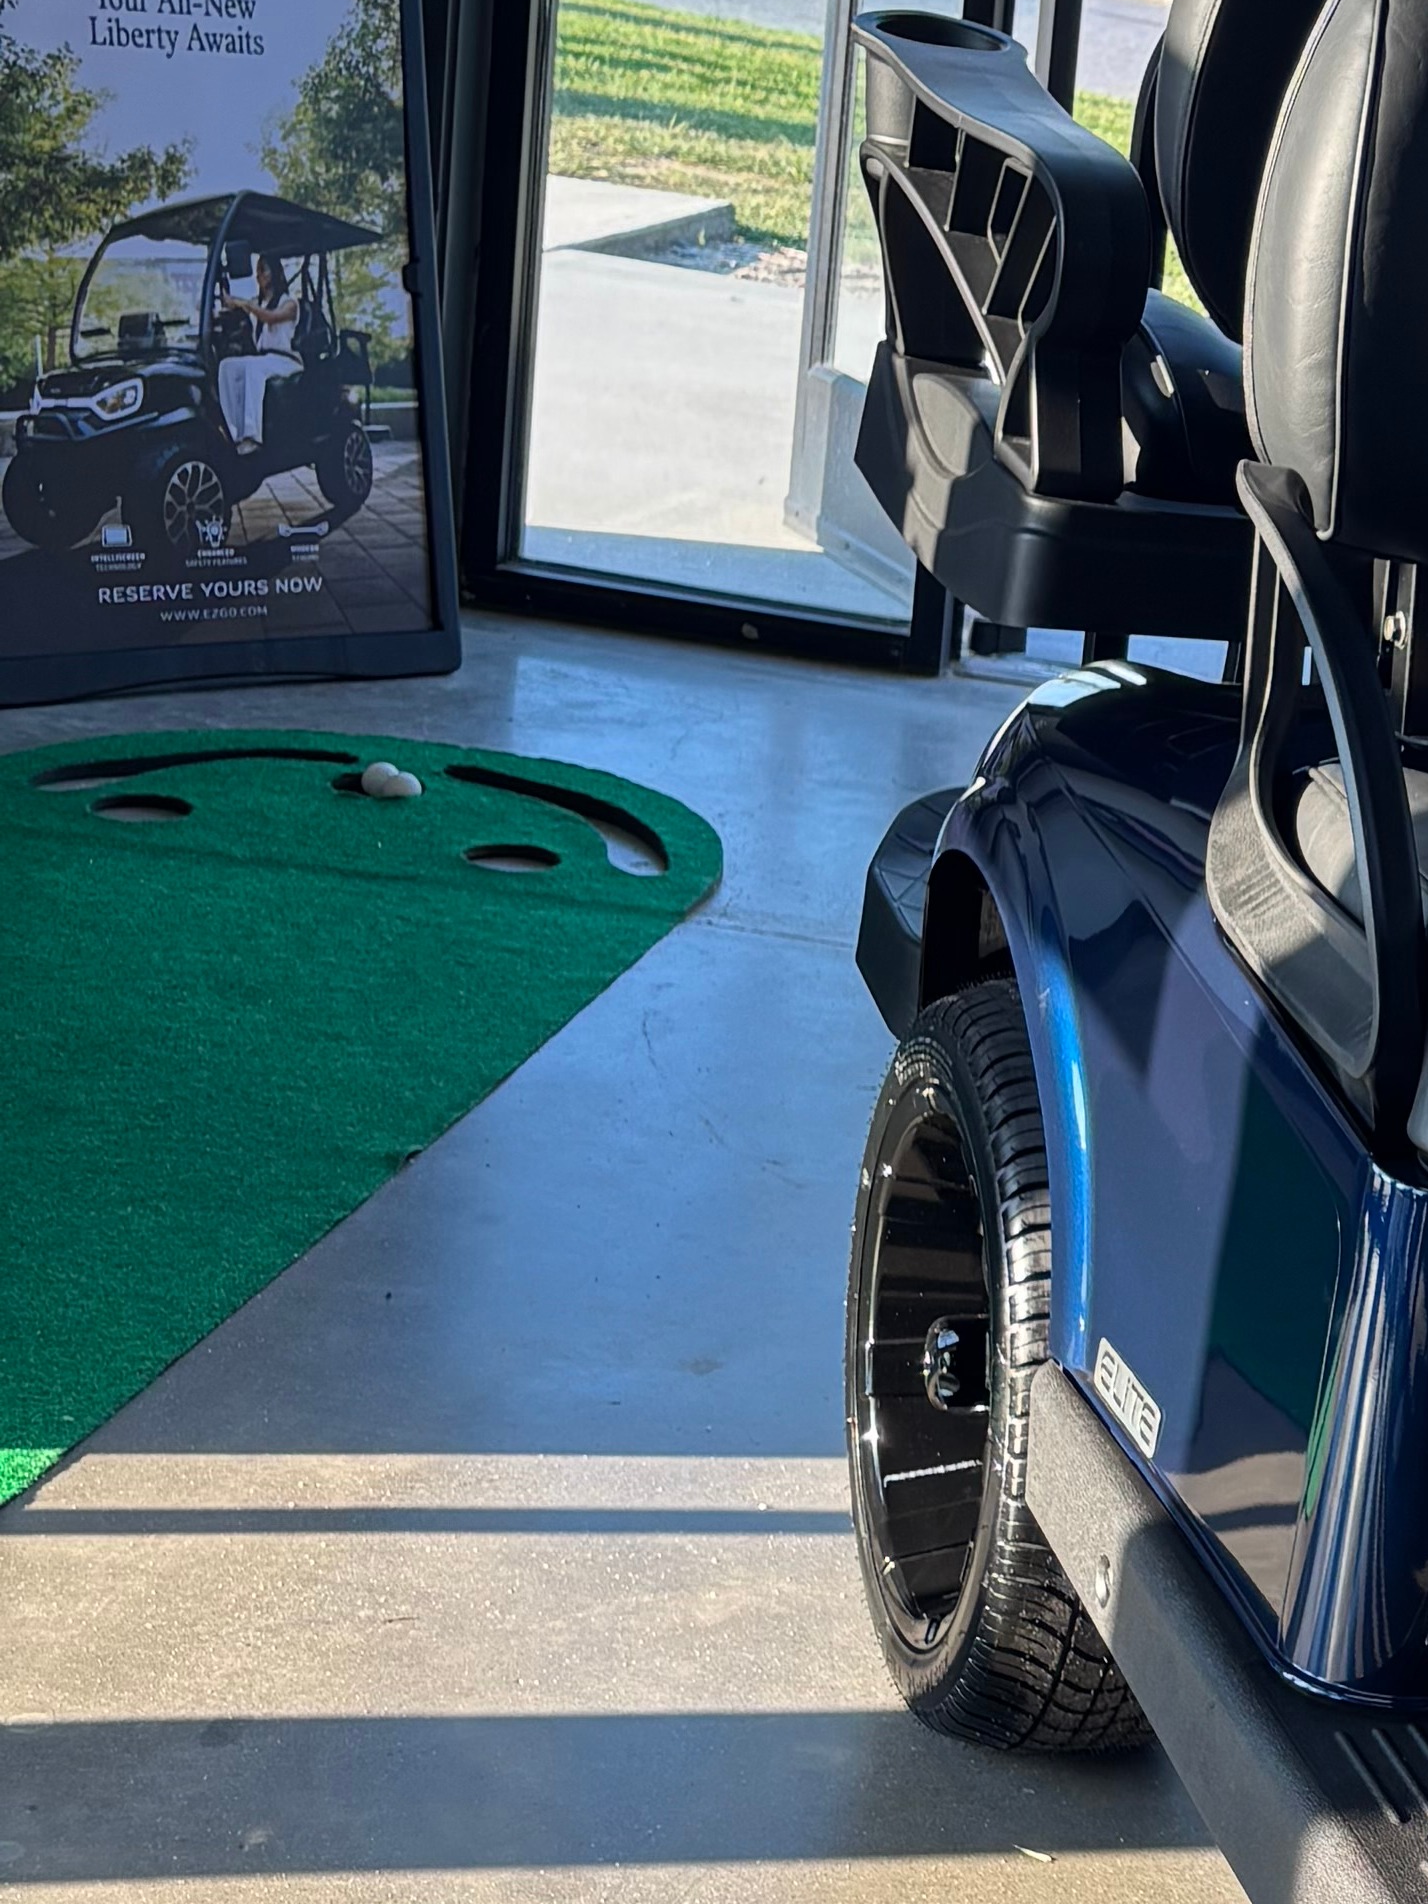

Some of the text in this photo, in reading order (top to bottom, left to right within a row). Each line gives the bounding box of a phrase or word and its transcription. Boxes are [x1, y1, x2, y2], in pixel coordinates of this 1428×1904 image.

[89, 16, 265, 59] Liberty Awaits
[99, 576, 323, 605] RESERVE YOURS NOW
